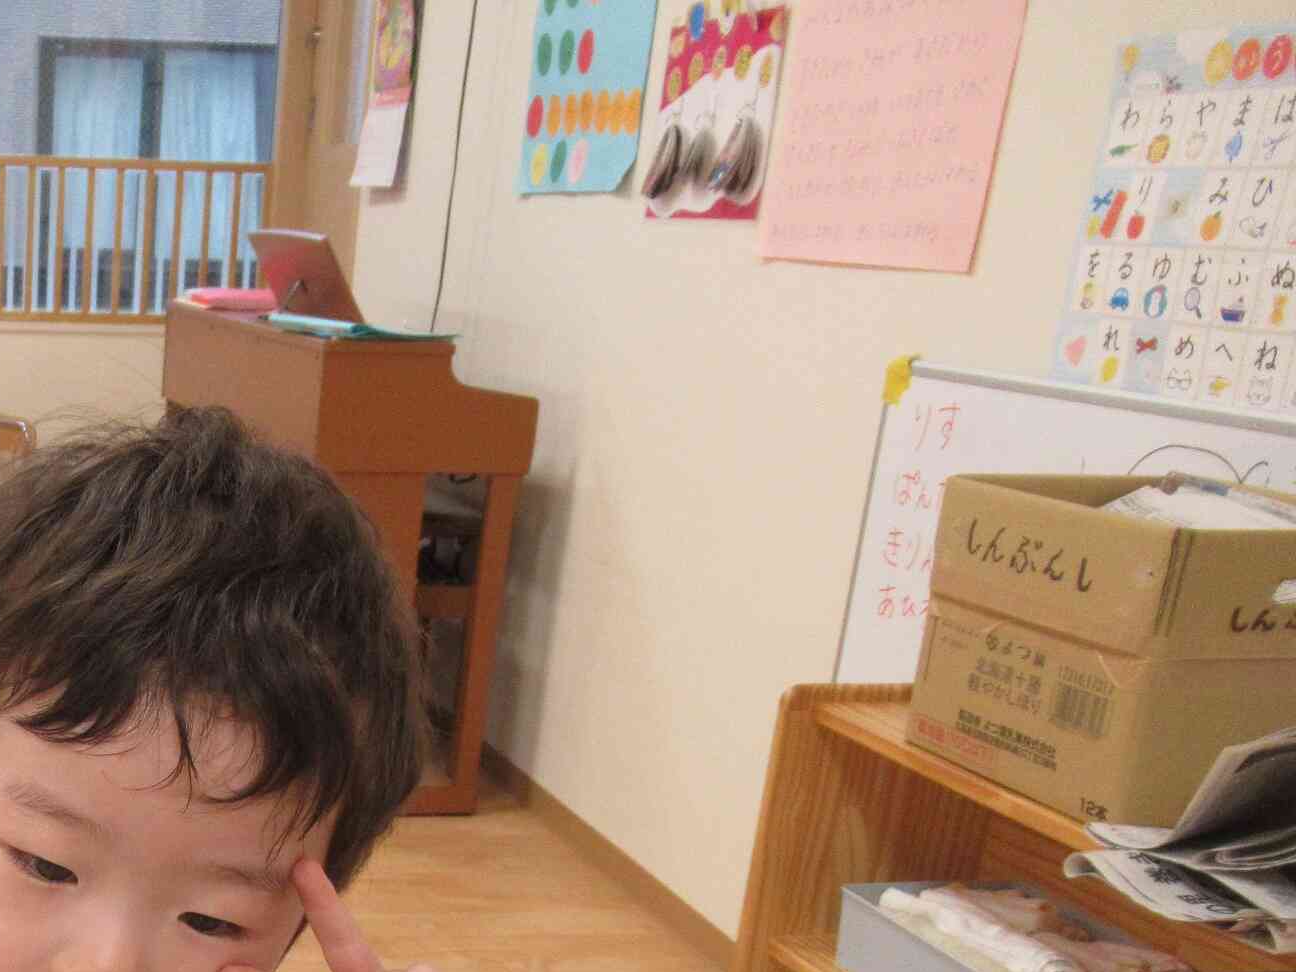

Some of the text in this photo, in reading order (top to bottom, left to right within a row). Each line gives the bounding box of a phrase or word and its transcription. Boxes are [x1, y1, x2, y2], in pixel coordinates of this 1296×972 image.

[1121, 101, 1141, 129] わ
[1159, 99, 1174, 128] ら
[1196, 97, 1216, 126] や
[1232, 94, 1253, 126] ま
[1137, 175, 1273, 207] り み ひ
[1117, 251, 1134, 280] る
[1151, 253, 1172, 281] ゆ
[1190, 254, 1213, 286] む
[1227, 257, 1250, 286] ふ
[1270, 261, 1296, 289] ぬ
[1102, 324, 1278, 371] れ め へ ね
[914, 401, 961, 451] りす
[964, 518, 1094, 595] しんぶんし
